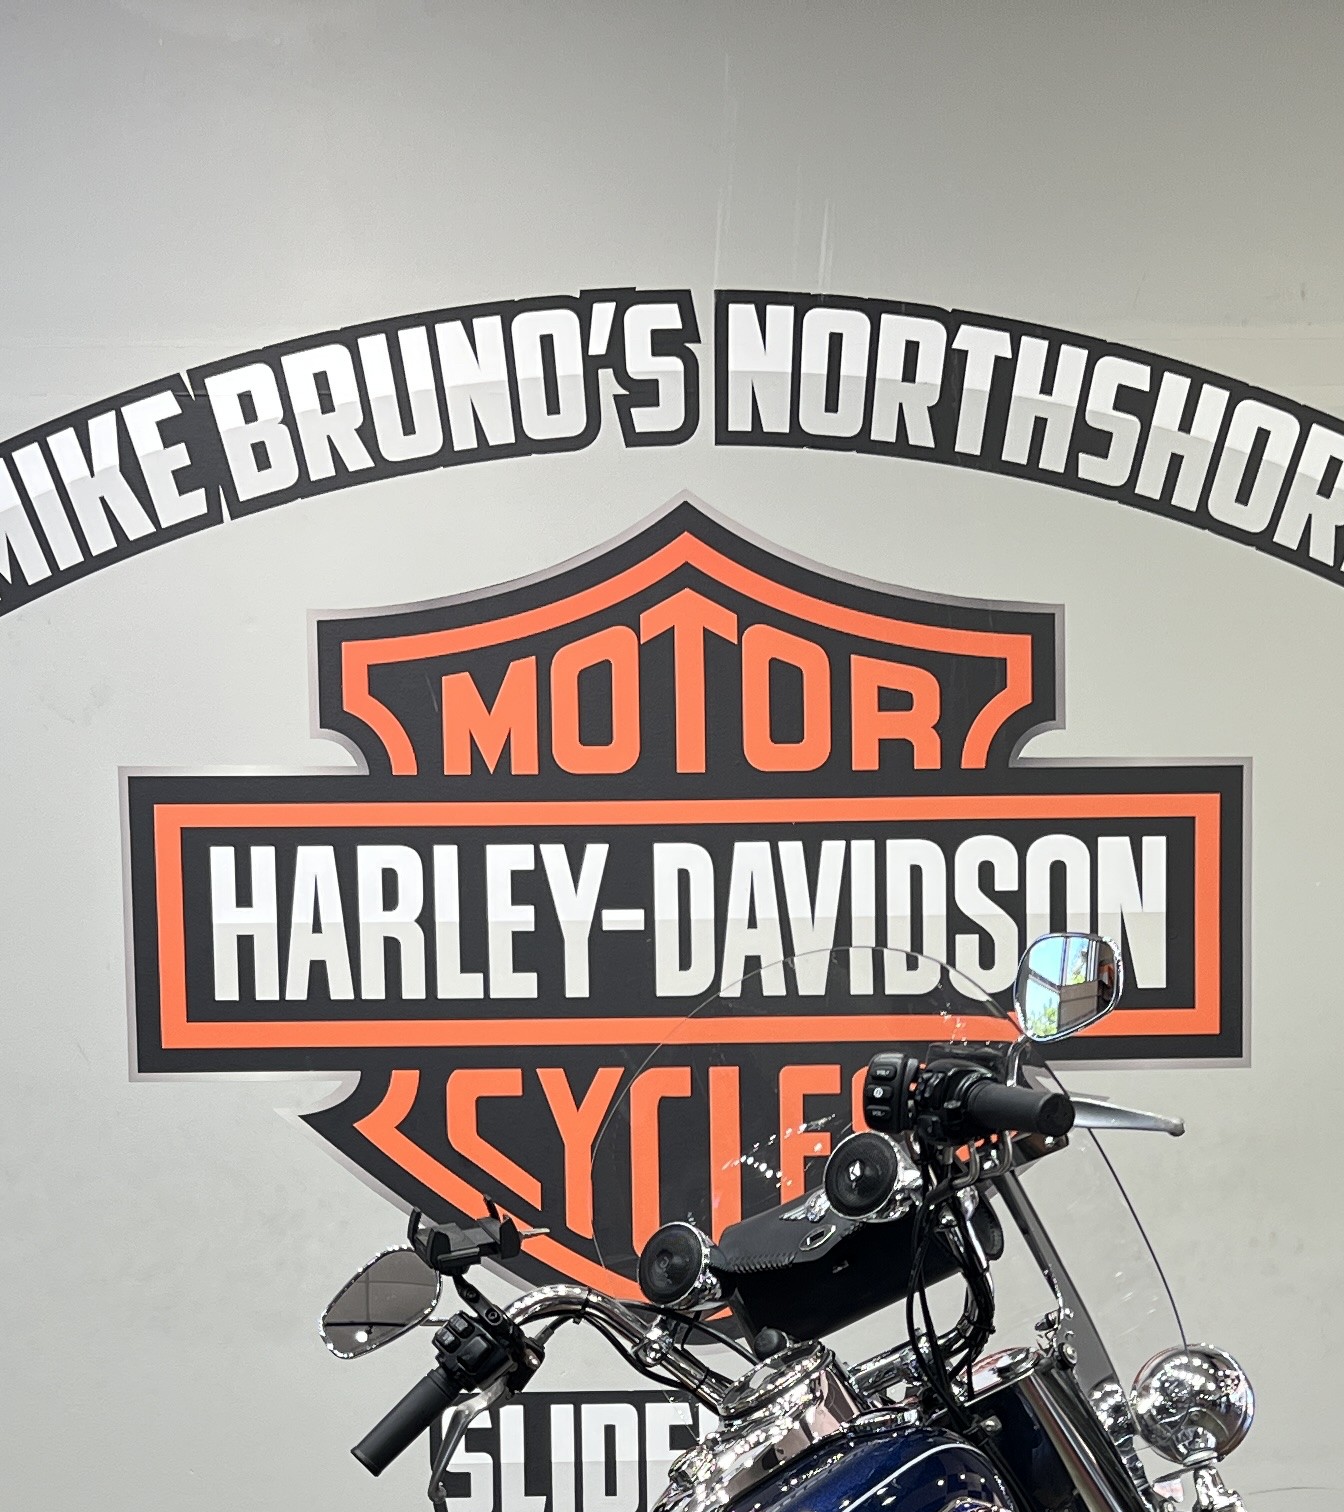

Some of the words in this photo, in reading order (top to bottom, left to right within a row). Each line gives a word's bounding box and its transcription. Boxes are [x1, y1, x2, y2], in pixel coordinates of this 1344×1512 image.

[203, 301, 686, 502] BRUNO'S
[442, 589, 942, 775] MOTOR
[208, 834, 1168, 1002] HARLEY-DAVIDSON
[446, 1064, 869, 1258] CYCLE
